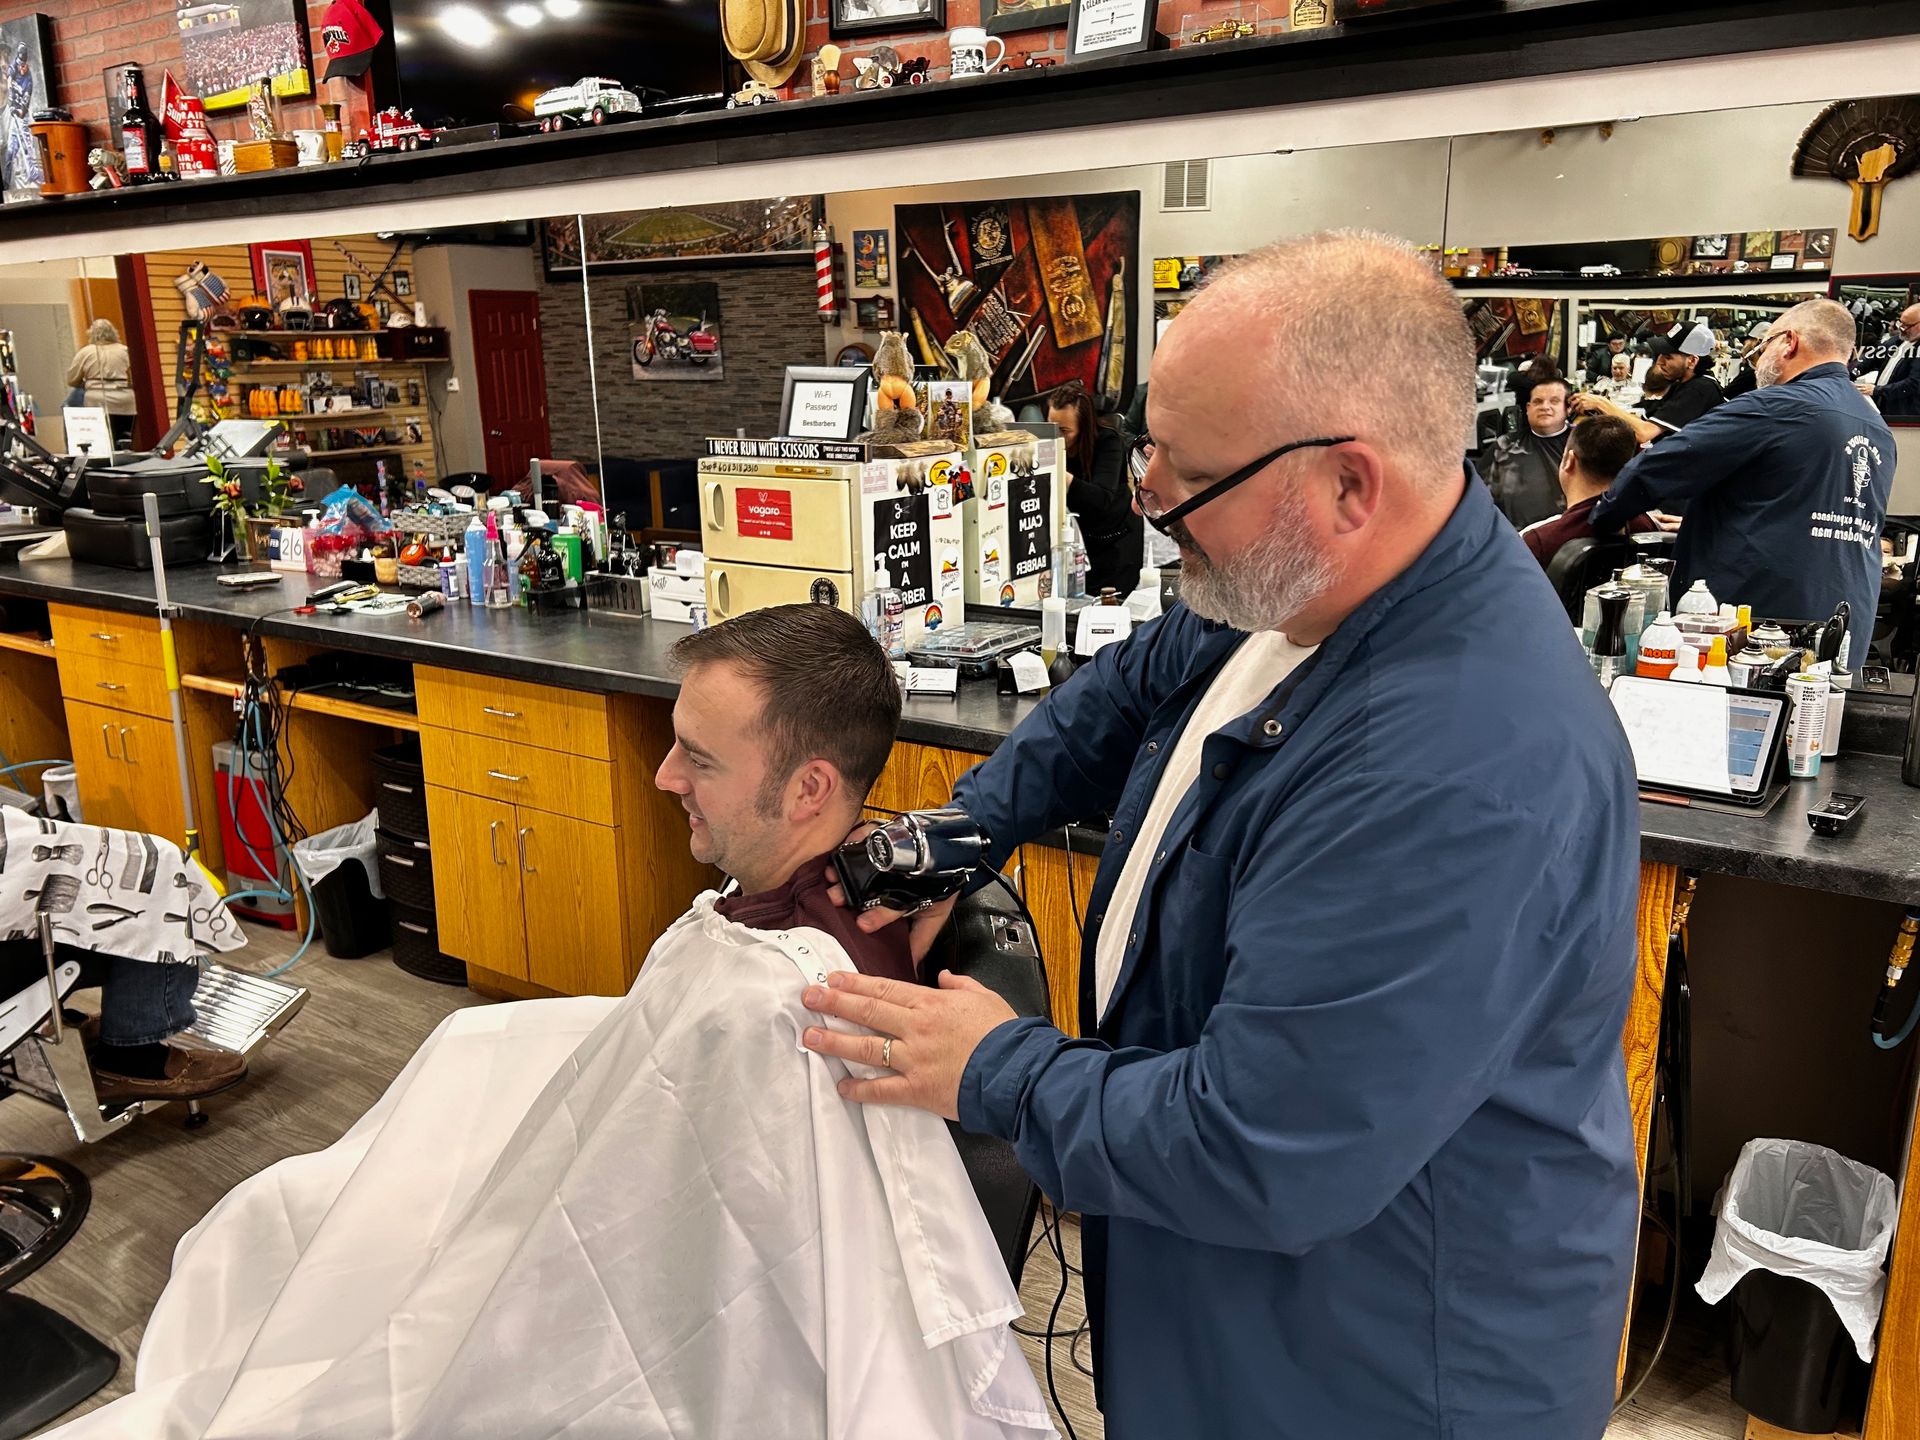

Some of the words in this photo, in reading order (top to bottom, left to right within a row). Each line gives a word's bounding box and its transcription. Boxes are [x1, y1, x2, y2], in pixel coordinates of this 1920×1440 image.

[814, 390, 832, 399] Wi-Fi
[805, 402, 838, 412] Password
[802, 419, 837, 428] Bestbarbers
[709, 440, 713, 454] I
[714, 440, 739, 456] NEVER
[740, 441, 757, 457] RUN
[758, 441, 780, 458] WITH
[781, 442, 820, 459] SCISSORS
[748, 505, 780, 517] vagaro
[889, 521, 918, 540] KEEP
[888, 540, 920, 559] CALM
[901, 572, 911, 587] A
[1643, 647, 1676, 659] MORE
